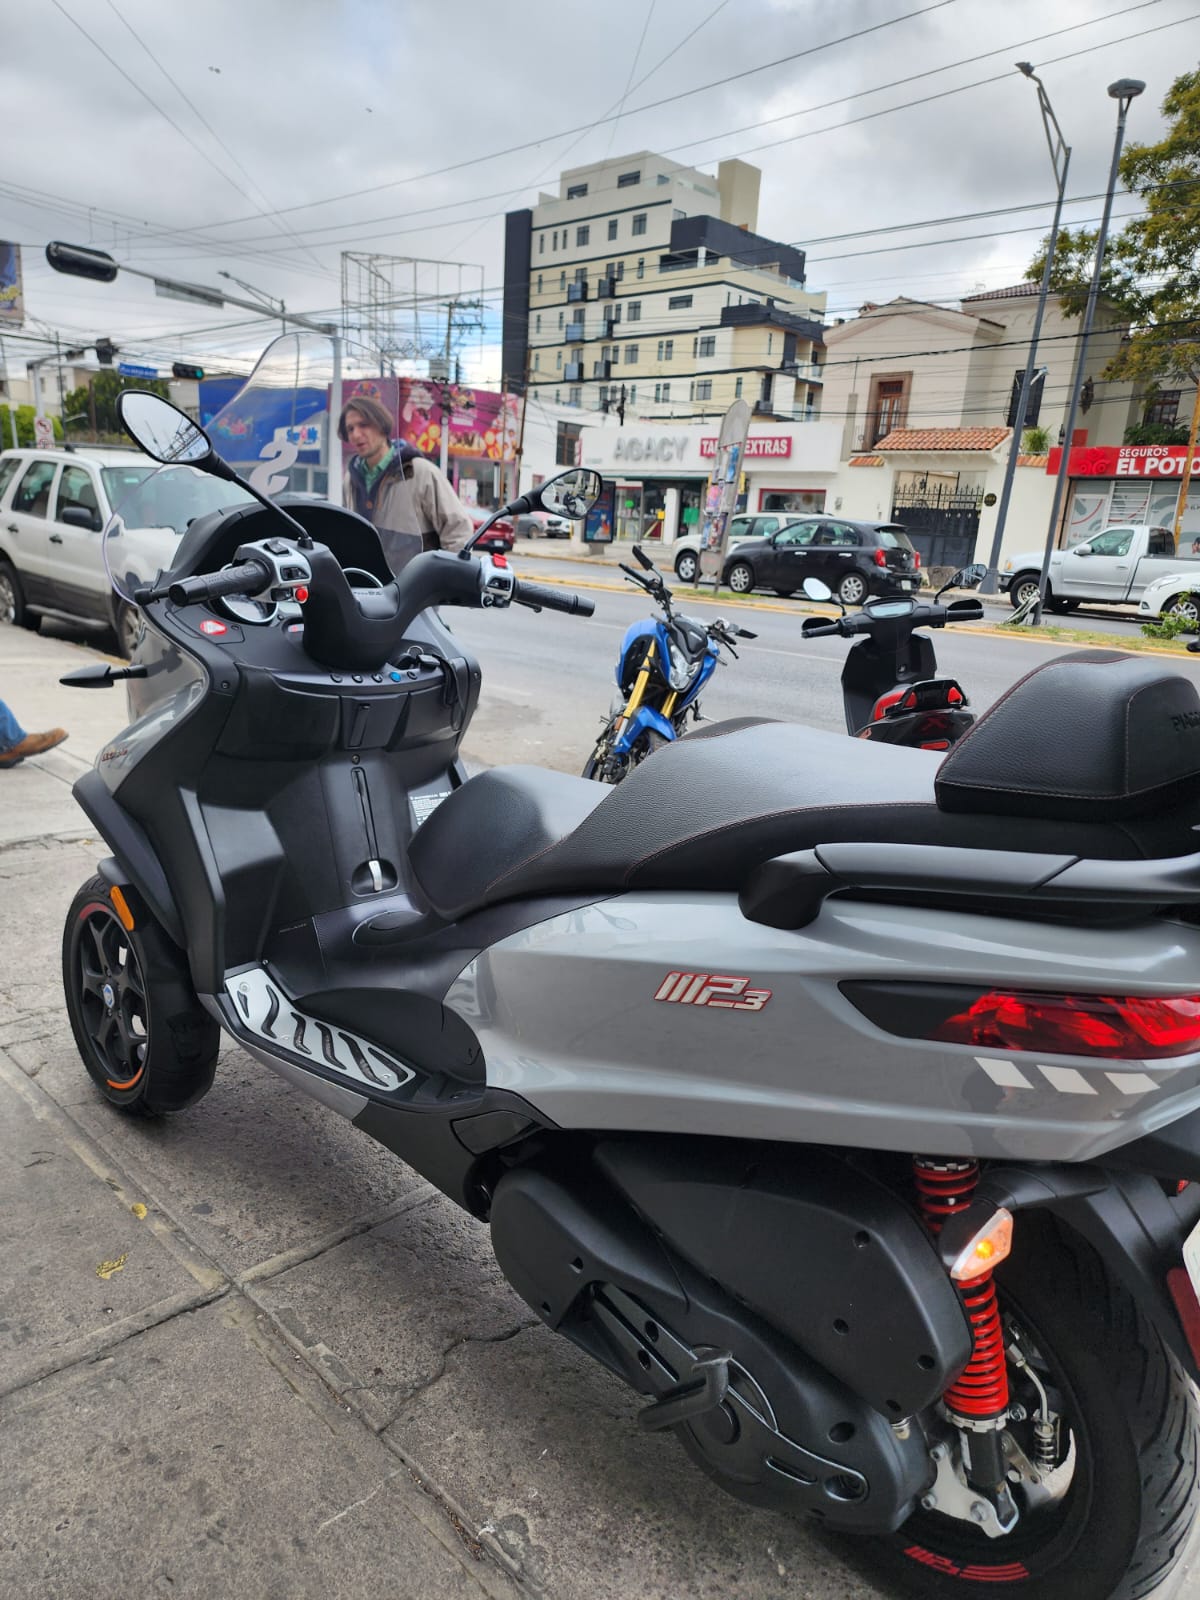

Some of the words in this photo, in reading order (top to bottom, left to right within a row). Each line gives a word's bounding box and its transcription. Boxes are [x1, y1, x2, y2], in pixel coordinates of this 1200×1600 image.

[744, 439, 788, 455] EXTRAS
[1119, 447, 1169, 457] SEGUROS
[1116, 457, 1140, 475] EL
[654, 970, 773, 1011] MP3
